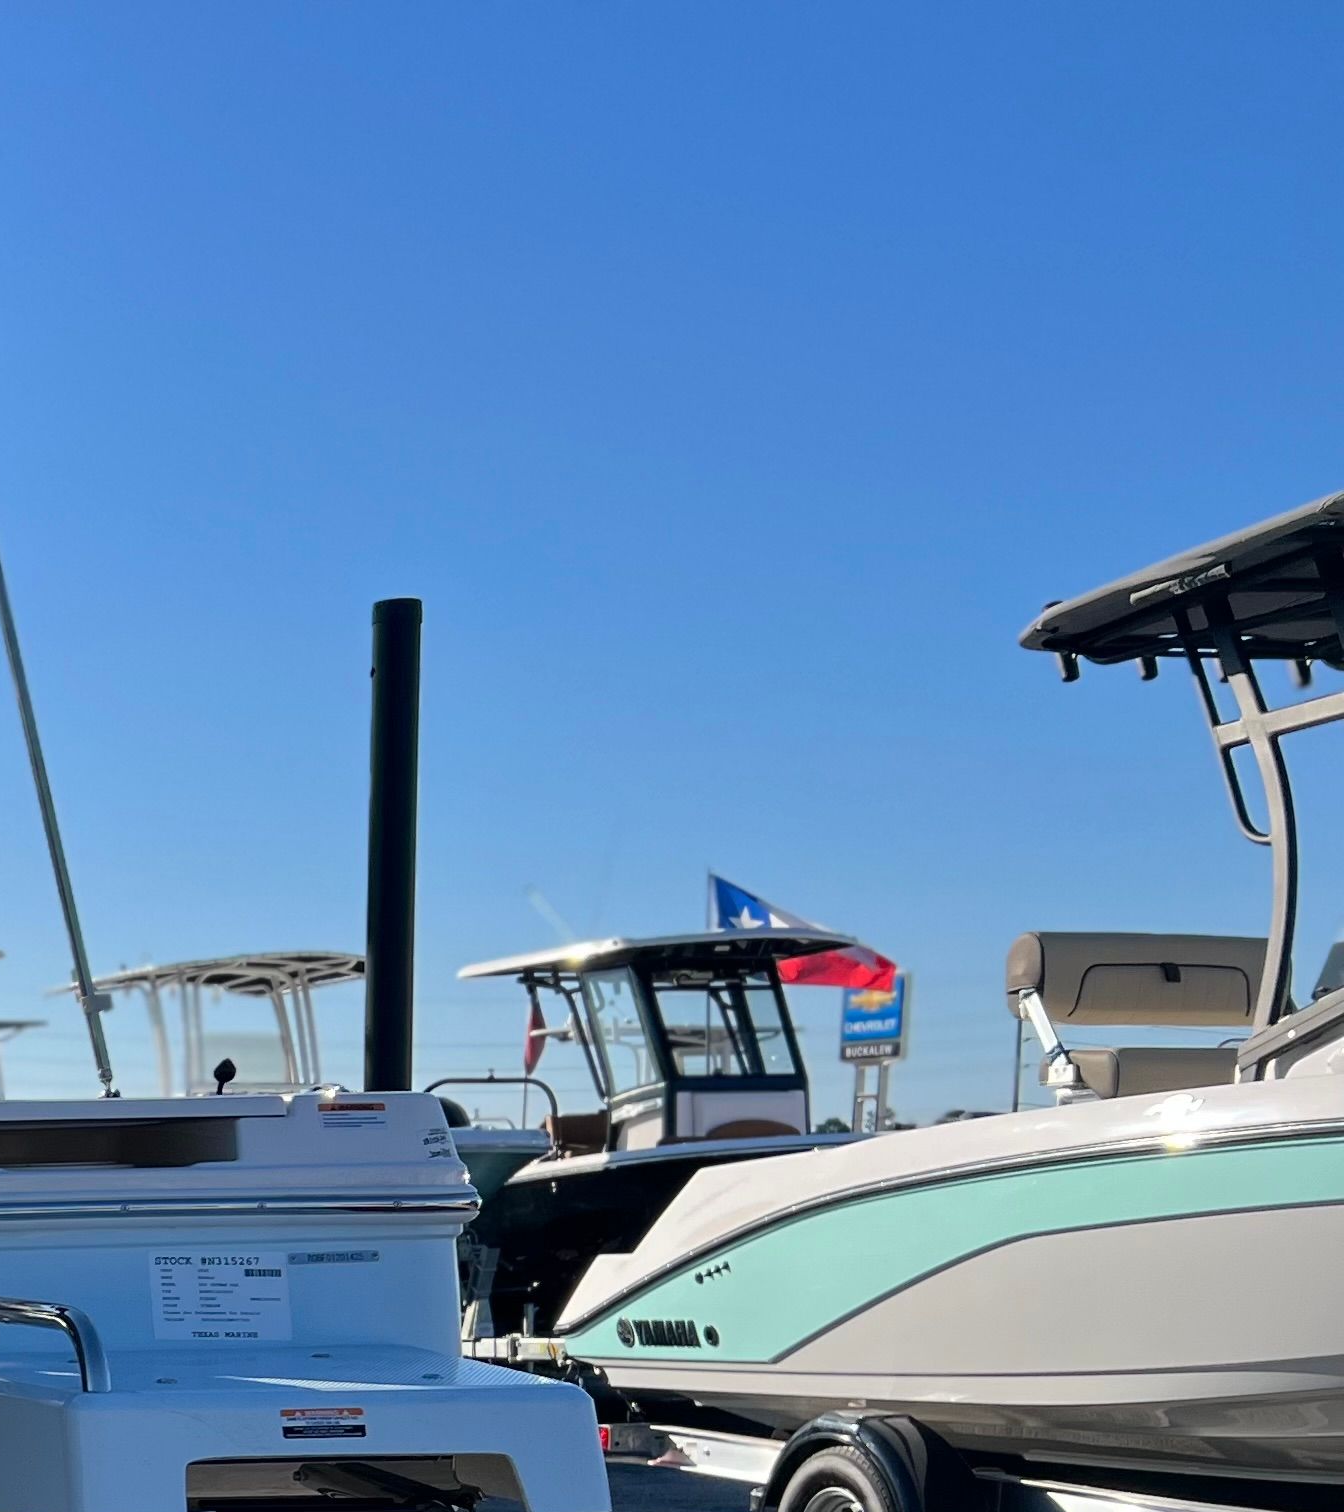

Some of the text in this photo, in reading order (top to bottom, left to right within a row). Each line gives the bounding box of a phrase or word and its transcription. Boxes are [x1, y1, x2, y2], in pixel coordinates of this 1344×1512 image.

[845, 1018, 896, 1033] CHEVROLET
[845, 1045, 893, 1058] BUCKALEW
[154, 1256, 260, 1266] STOCK #N315267
[632, 1320, 701, 1348] YAMAHA
